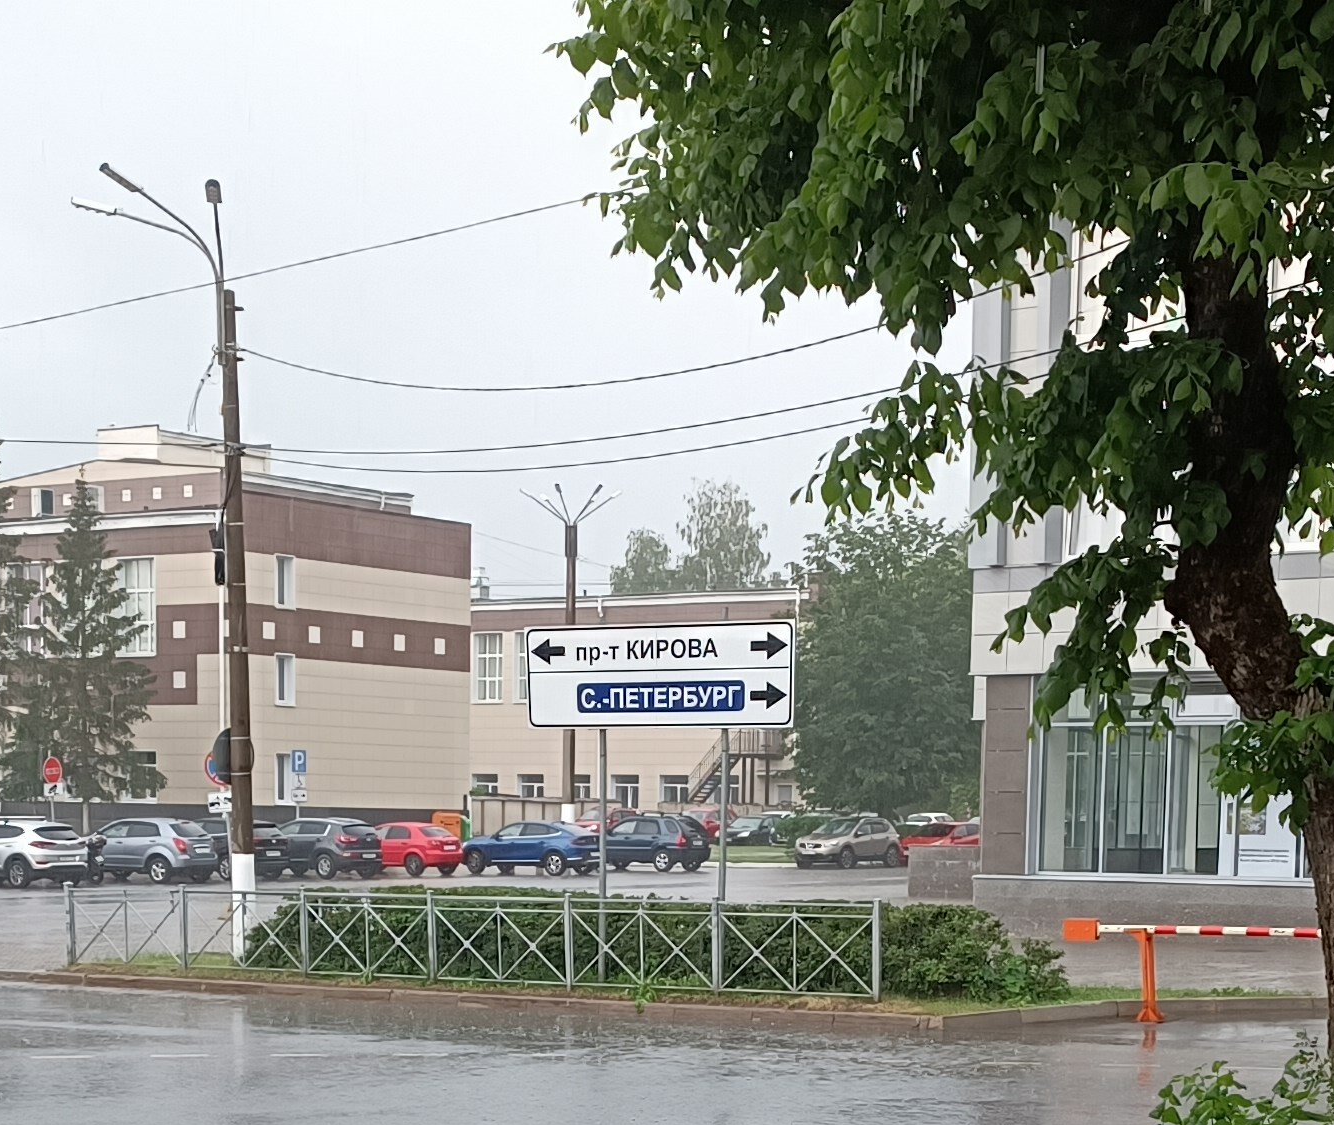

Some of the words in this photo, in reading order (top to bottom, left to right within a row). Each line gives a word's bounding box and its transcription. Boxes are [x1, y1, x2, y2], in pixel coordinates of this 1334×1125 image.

[576, 644, 619, 665] пр-т
[626, 638, 718, 661] КИРОВА
[580, 686, 741, 709] С.-ПЕТЕРБУРГ
[295, 751, 304, 771] P
